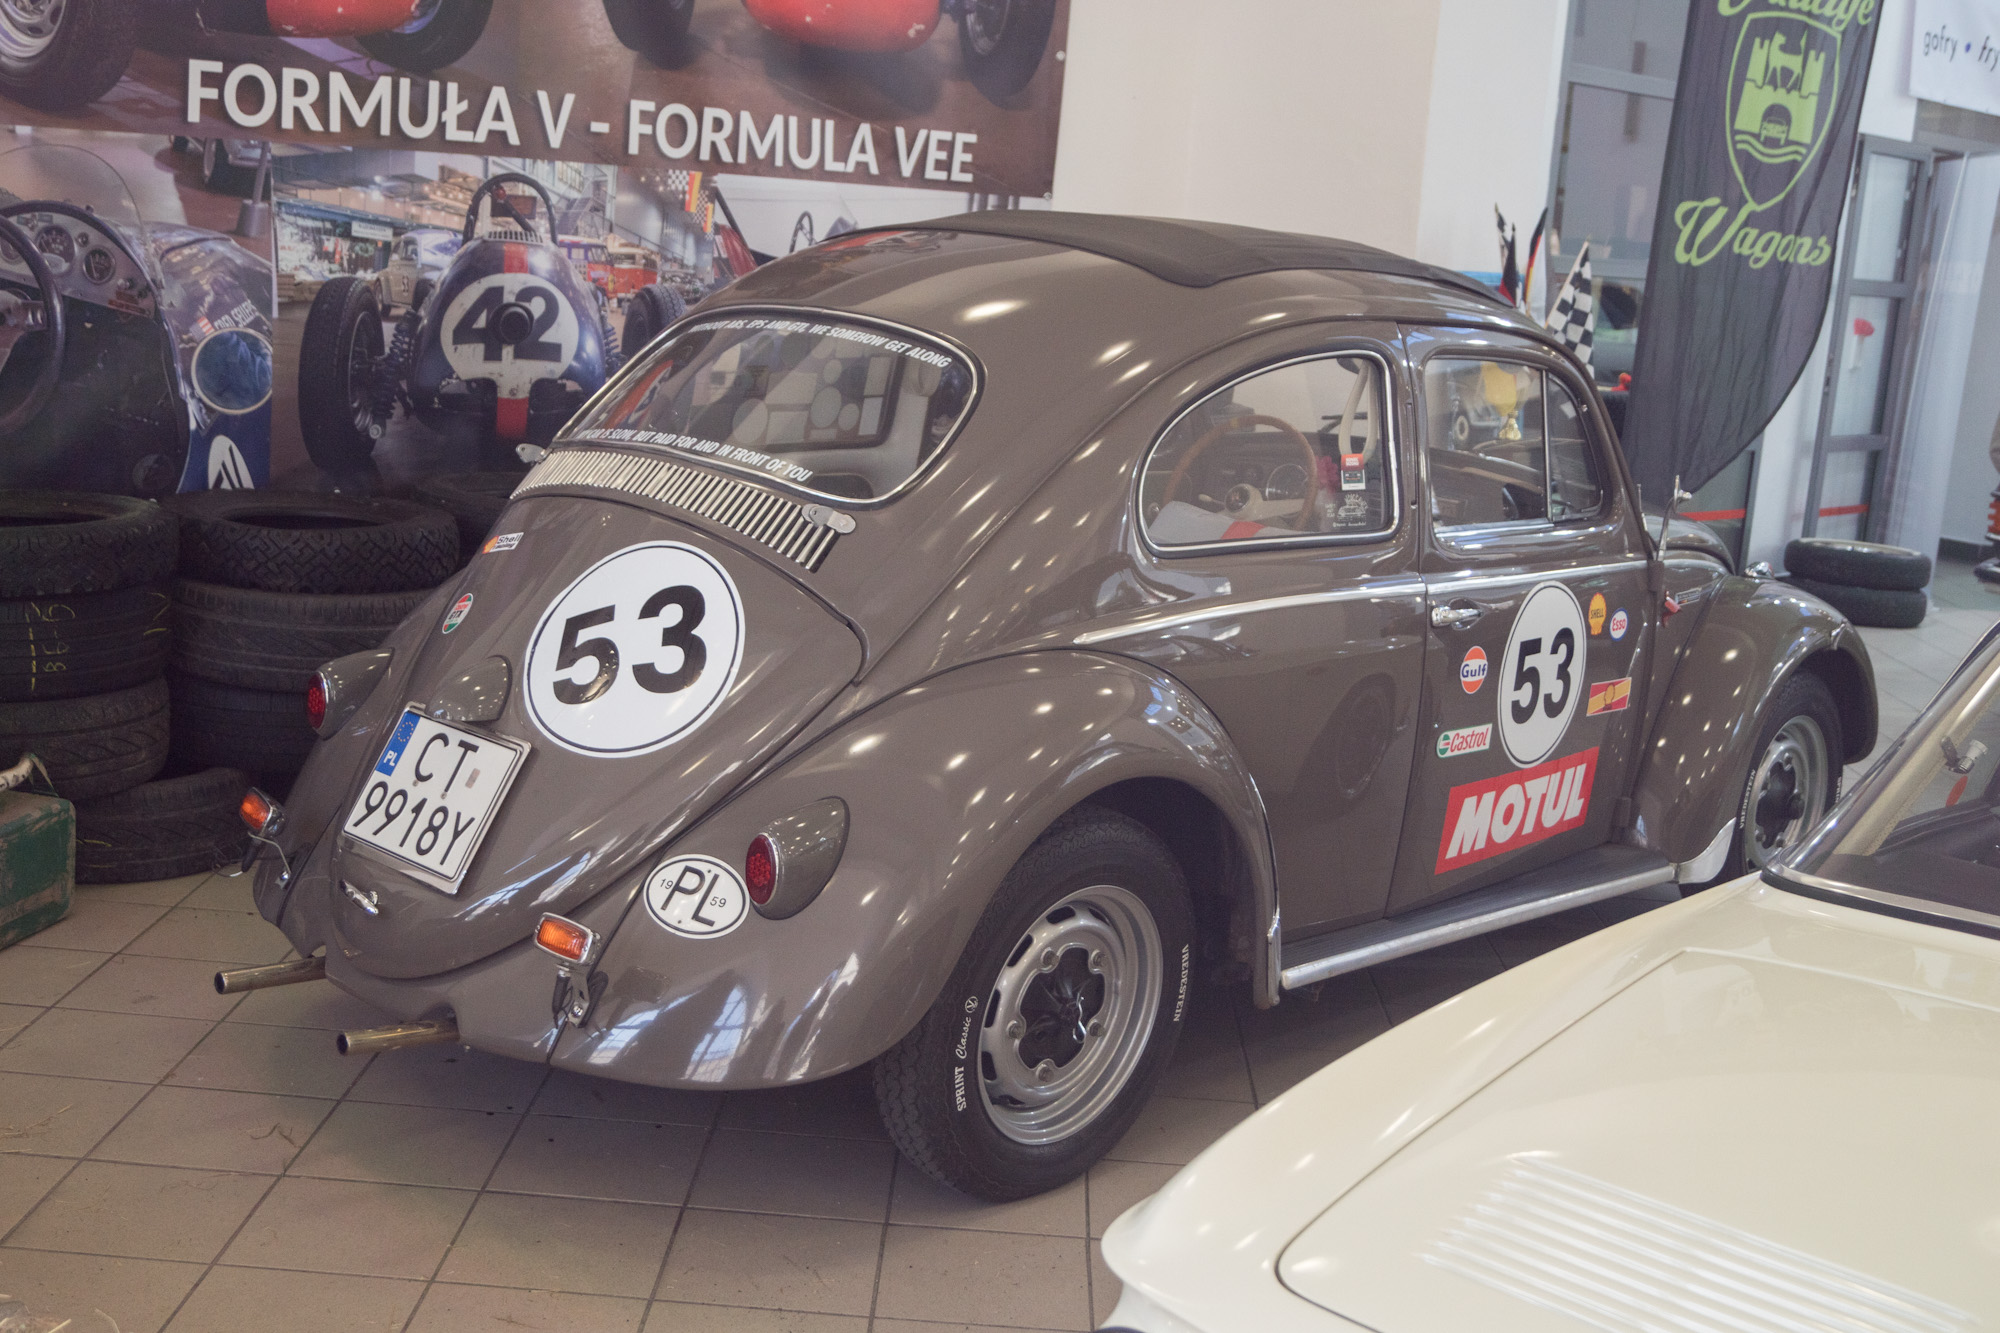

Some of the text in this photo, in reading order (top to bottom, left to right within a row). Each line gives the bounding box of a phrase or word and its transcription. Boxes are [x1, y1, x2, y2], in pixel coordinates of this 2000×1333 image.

[1923, 24, 1957, 63] gofry
[187, 57, 521, 146] FORMUŁA
[536, 89, 576, 149] V
[627, 98, 880, 176] FORMULA
[894, 125, 979, 183] VEE
[1674, 196, 1832, 269] Wagons
[452, 284, 563, 363] 42
[763, 320, 791, 330] AND
[808, 323, 831, 336] WE
[826, 327, 890, 347] SOMEHOW
[884, 339, 912, 354] GET
[905, 347, 953, 368] ALONG
[632, 430, 656, 442] BUT
[649, 432, 678, 446] PAID
[672, 435, 698, 449] FOR
[691, 439, 720, 454] AND
[715, 443, 735, 457] IN
[728, 446, 771, 467] FRONT
[765, 458, 787, 473] OF
[782, 463, 814, 482] YOU
[552, 584, 708, 705] 53
[1461, 663, 1488, 679] Gulf
[1510, 626, 1575, 725] 53
[383, 750, 399, 767] PL
[414, 732, 480, 793] CT
[1450, 727, 1490, 753] Castrol
[353, 780, 476, 866] 9918Y
[1445, 763, 1588, 860] MOTUL
[660, 865, 727, 927] 19 PL 59
[1173, 943, 1190, 1022] VREDESTEIN
[954, 1016, 972, 1112] SPRINT Classic
